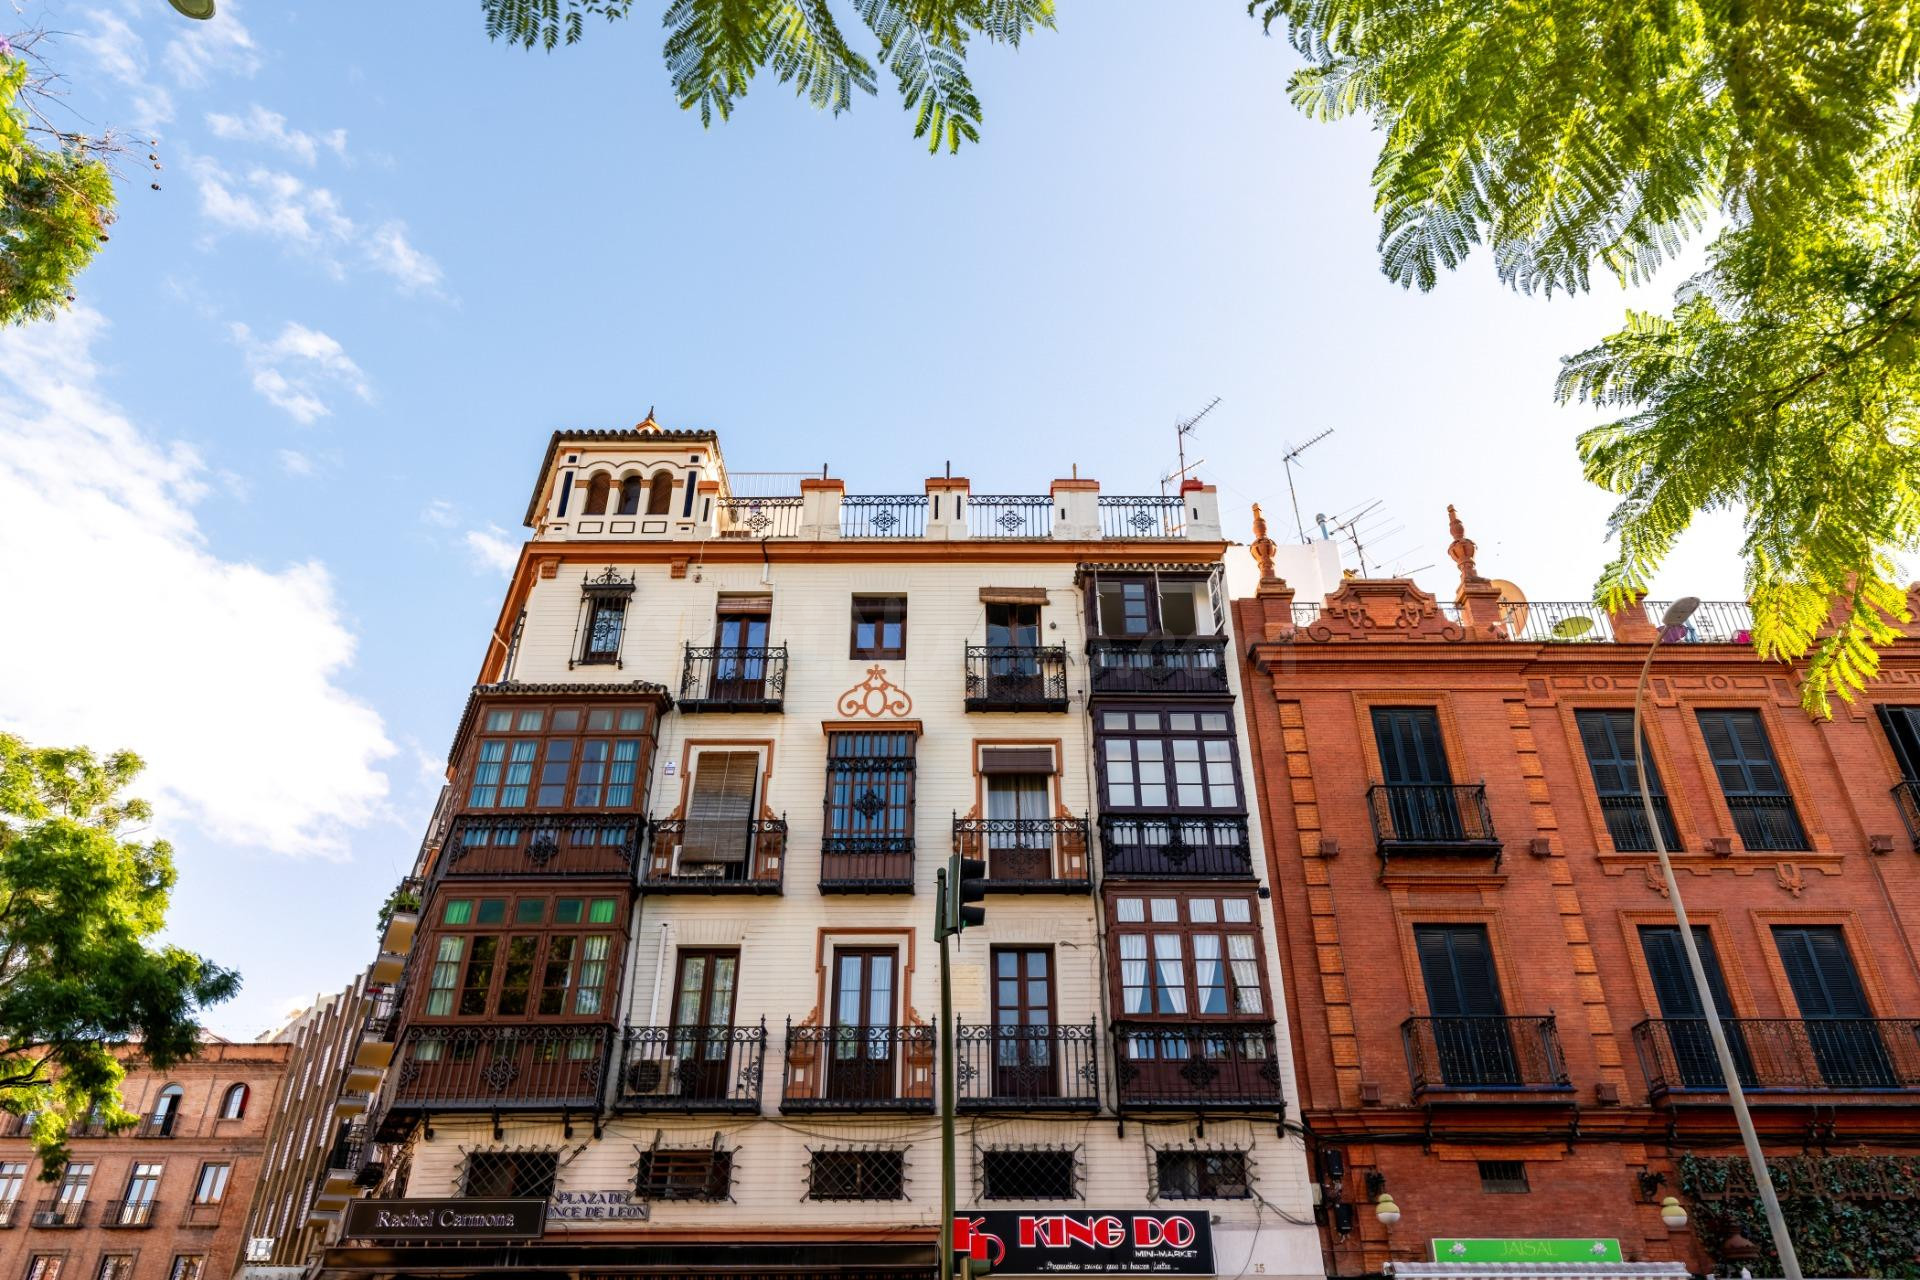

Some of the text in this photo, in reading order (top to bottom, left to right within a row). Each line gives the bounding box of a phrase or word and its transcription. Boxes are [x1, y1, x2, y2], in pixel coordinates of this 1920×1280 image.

[559, 1192, 607, 1205] PLAZA
[375, 1209, 515, 1228] Rachel Carmona
[546, 1206, 582, 1218] ONCE
[585, 1206, 604, 1218] DE
[1018, 1215, 1196, 1249] KING DO
[1254, 1263, 1265, 1273] 15
